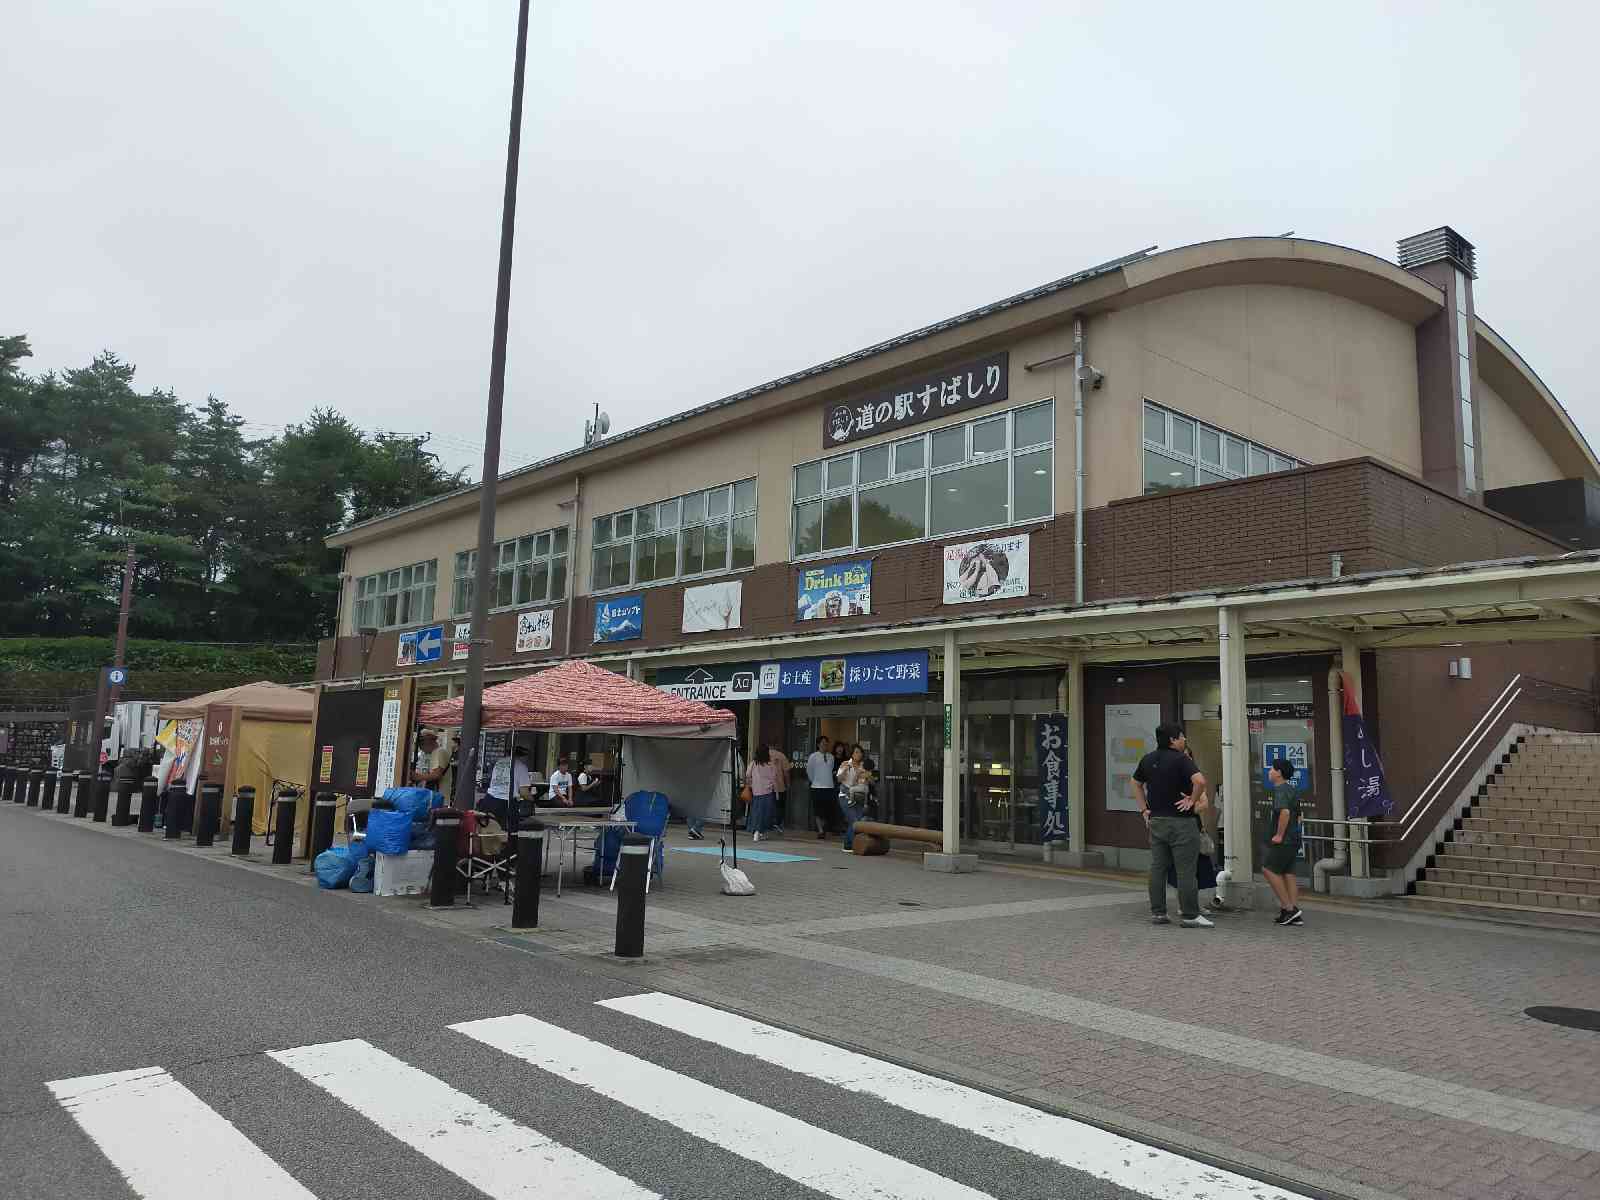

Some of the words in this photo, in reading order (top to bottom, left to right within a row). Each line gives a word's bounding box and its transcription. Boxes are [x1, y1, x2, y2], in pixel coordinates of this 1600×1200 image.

[855, 365, 1001, 432] 道の駅すばしり
[805, 573, 842, 590] Drink
[844, 570, 867, 586] Bar
[782, 669, 812, 685] お土産
[849, 663, 921, 682] 採りたて野菜
[736, 677, 749, 689] 入口
[671, 685, 726, 700] ENTRANCE
[1288, 745, 1304, 757] 24
[1041, 723, 1065, 836] お食事処
